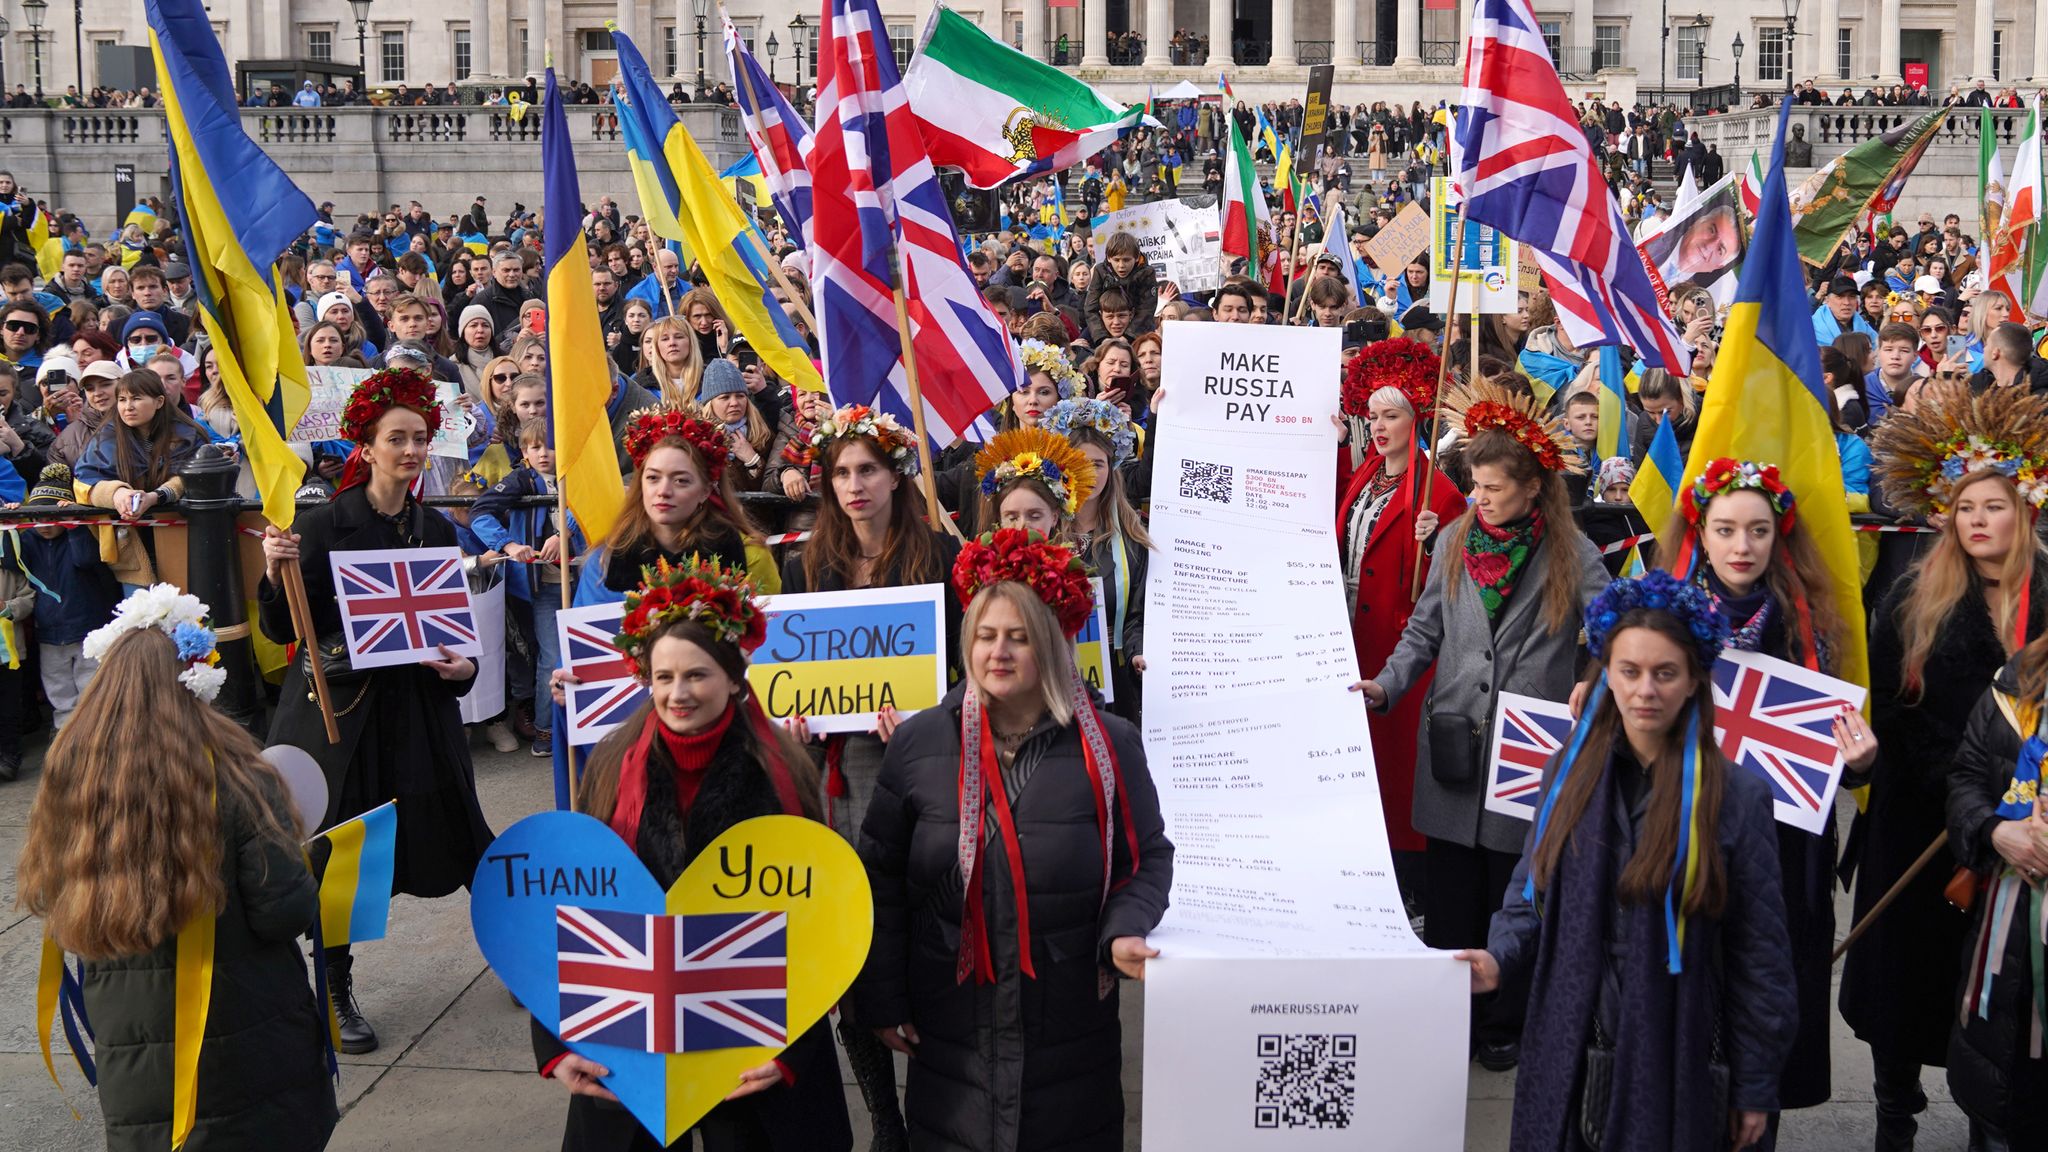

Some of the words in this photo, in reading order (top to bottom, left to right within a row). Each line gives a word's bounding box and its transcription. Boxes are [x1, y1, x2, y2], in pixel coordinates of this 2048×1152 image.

[1650, 273, 1661, 286] OF
[1655, 287, 1671, 311] IRAN
[1221, 352, 1280, 373] MAKE
[1204, 376, 1294, 399] RUSSIA
[1226, 402, 1271, 422] PAY
[1275, 415, 1297, 424] $300
[1302, 416, 1313, 424] BN
[1245, 474, 1264, 482] $300
[1246, 468, 1308, 479] #MAKERUSSIAPAY
[1258, 481, 1285, 490] FROZEN
[1245, 486, 1276, 495] RUSSIAN
[1280, 490, 1307, 499] ASSETS
[1246, 498, 1290, 509] 24.02.2024
[1179, 508, 1202, 516] CRIME
[1174, 538, 1206, 548] DAMAGE
[1174, 546, 1212, 557] HOUSING
[1173, 562, 1233, 575] DESTRUCTION
[1174, 570, 1249, 584] INFRASTRUCTURE
[771, 612, 915, 663] STRONG
[1231, 678, 1285, 688] EDUCATION
[1171, 691, 1208, 699] SYSTEM
[1347, 745, 1362, 753] BN
[1172, 751, 1236, 761] HEALTHCARE
[1172, 758, 1249, 768] DESTRUCTIONS
[1351, 770, 1366, 779] BN
[1225, 781, 1264, 789] LOSSES
[488, 853, 619, 898] THANK
[1251, 1003, 1360, 1014] #MAKERUSSIAPAY
